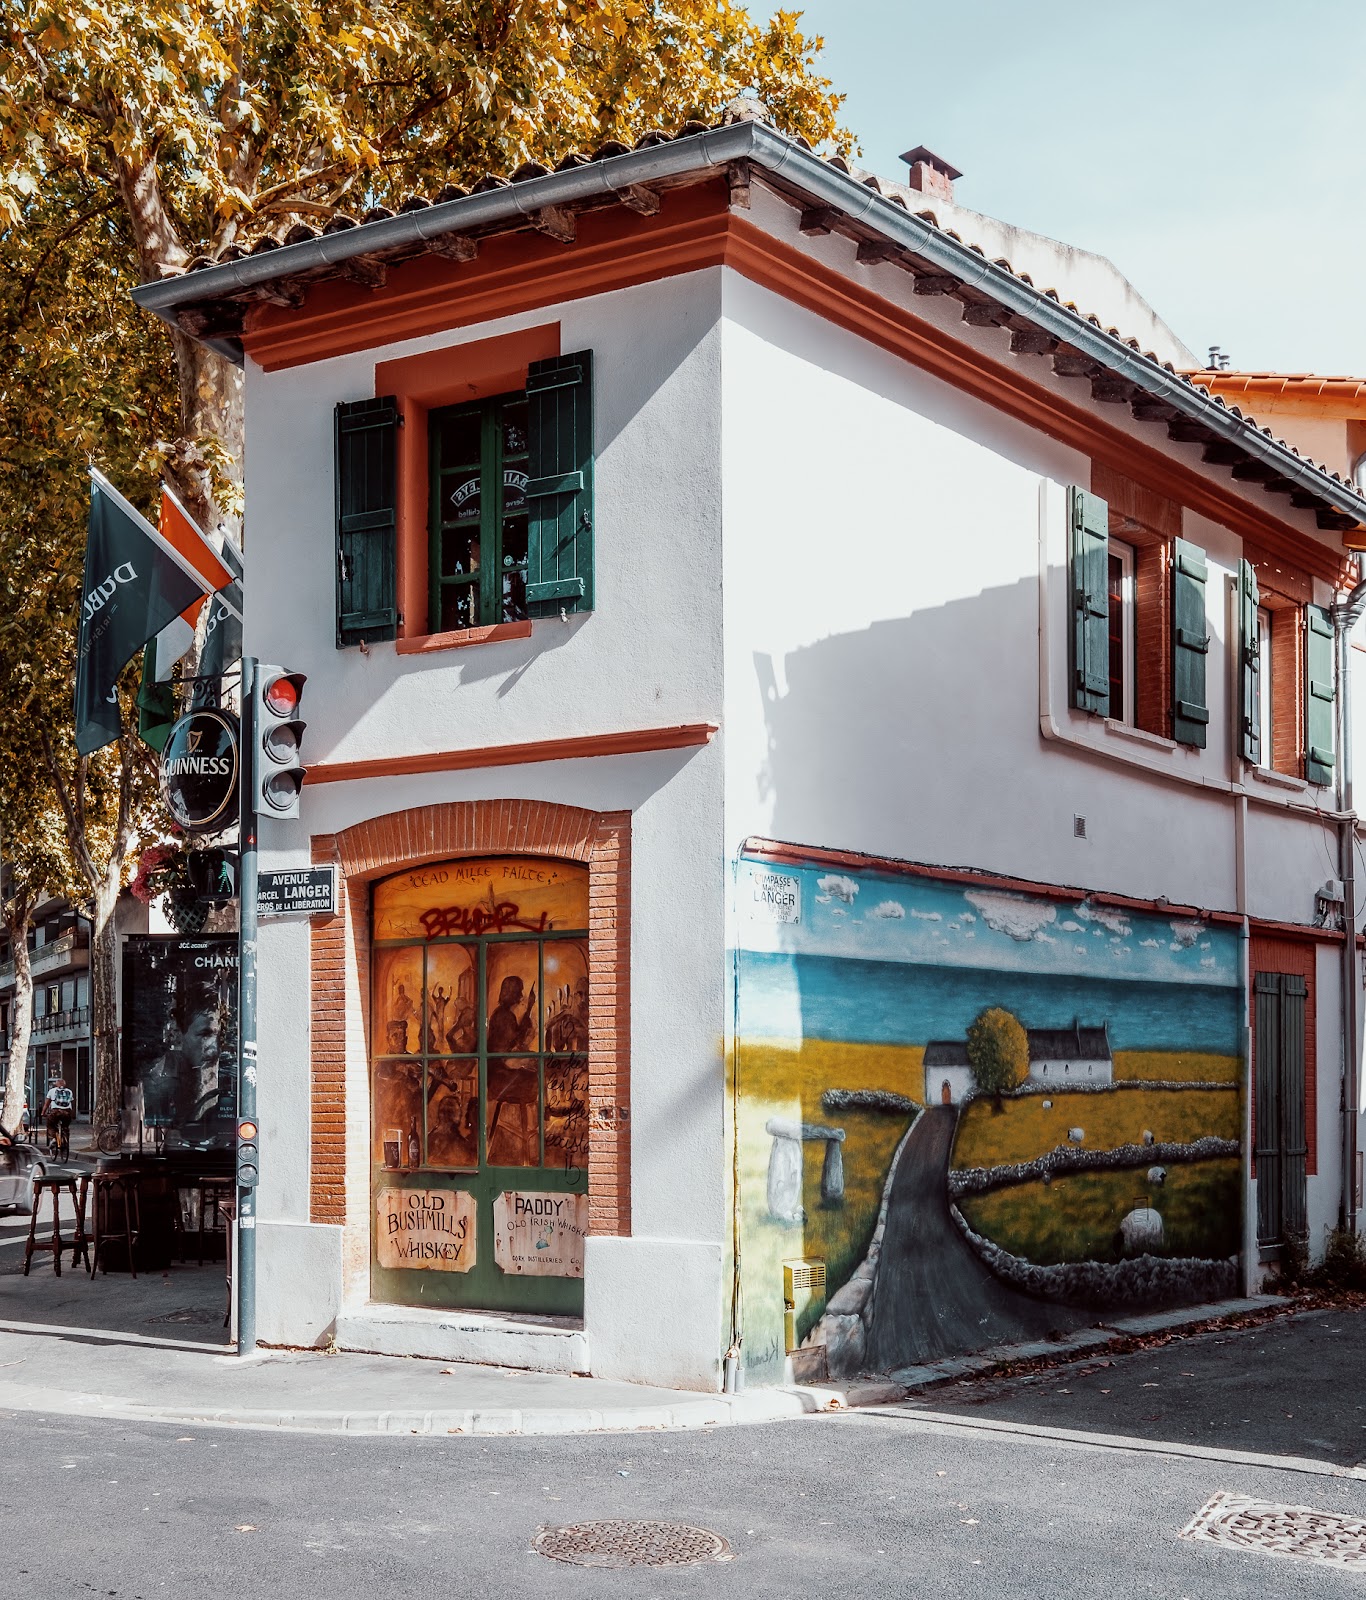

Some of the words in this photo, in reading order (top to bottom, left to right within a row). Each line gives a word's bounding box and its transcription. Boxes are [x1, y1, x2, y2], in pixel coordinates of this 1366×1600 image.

[163, 756, 230, 777] GUINNESS
[272, 873, 310, 886] AVENUE
[455, 866, 493, 880] MILLE
[257, 891, 279, 900] ARCEL
[284, 884, 330, 899] LANGER
[754, 891, 795, 906] LANGER
[257, 902, 274, 912] ÉROS
[292, 899, 330, 910] LIBÉRATION
[194, 956, 240, 968] CHANE
[408, 1194, 445, 1210] OLD
[515, 1197, 564, 1216] PADDY
[387, 1209, 468, 1239] BUSHMILLS
[507, 1220, 527, 1230] OLD
[530, 1217, 555, 1227] IRISH
[557, 1217, 589, 1239] WHISKE
[393, 1237, 463, 1260] WHISKEY
